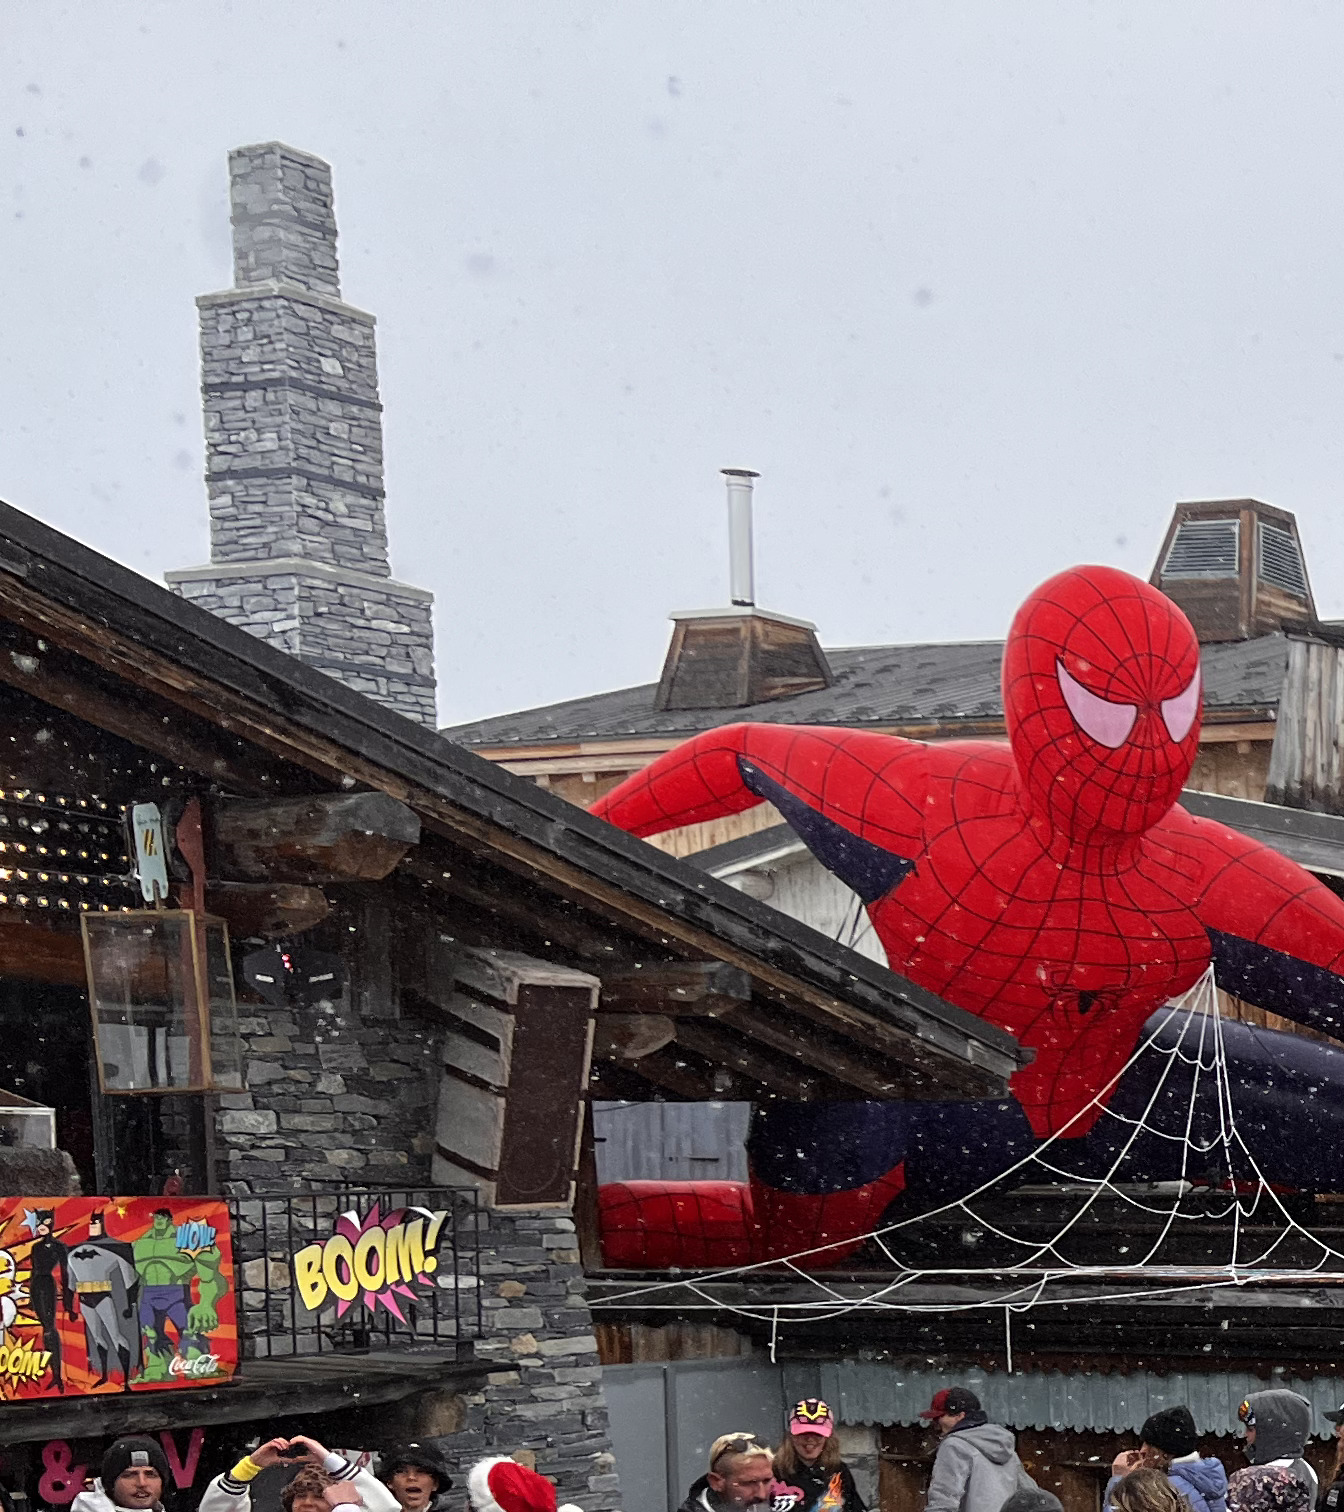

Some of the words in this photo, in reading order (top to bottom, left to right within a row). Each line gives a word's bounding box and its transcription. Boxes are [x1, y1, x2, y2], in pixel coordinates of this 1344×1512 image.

[176, 1221, 217, 1250] WOW!
[293, 1209, 449, 1312] BOOM!
[0, 1345, 53, 1376] OOM!
[168, 1353, 221, 1377] Coca-Cola
